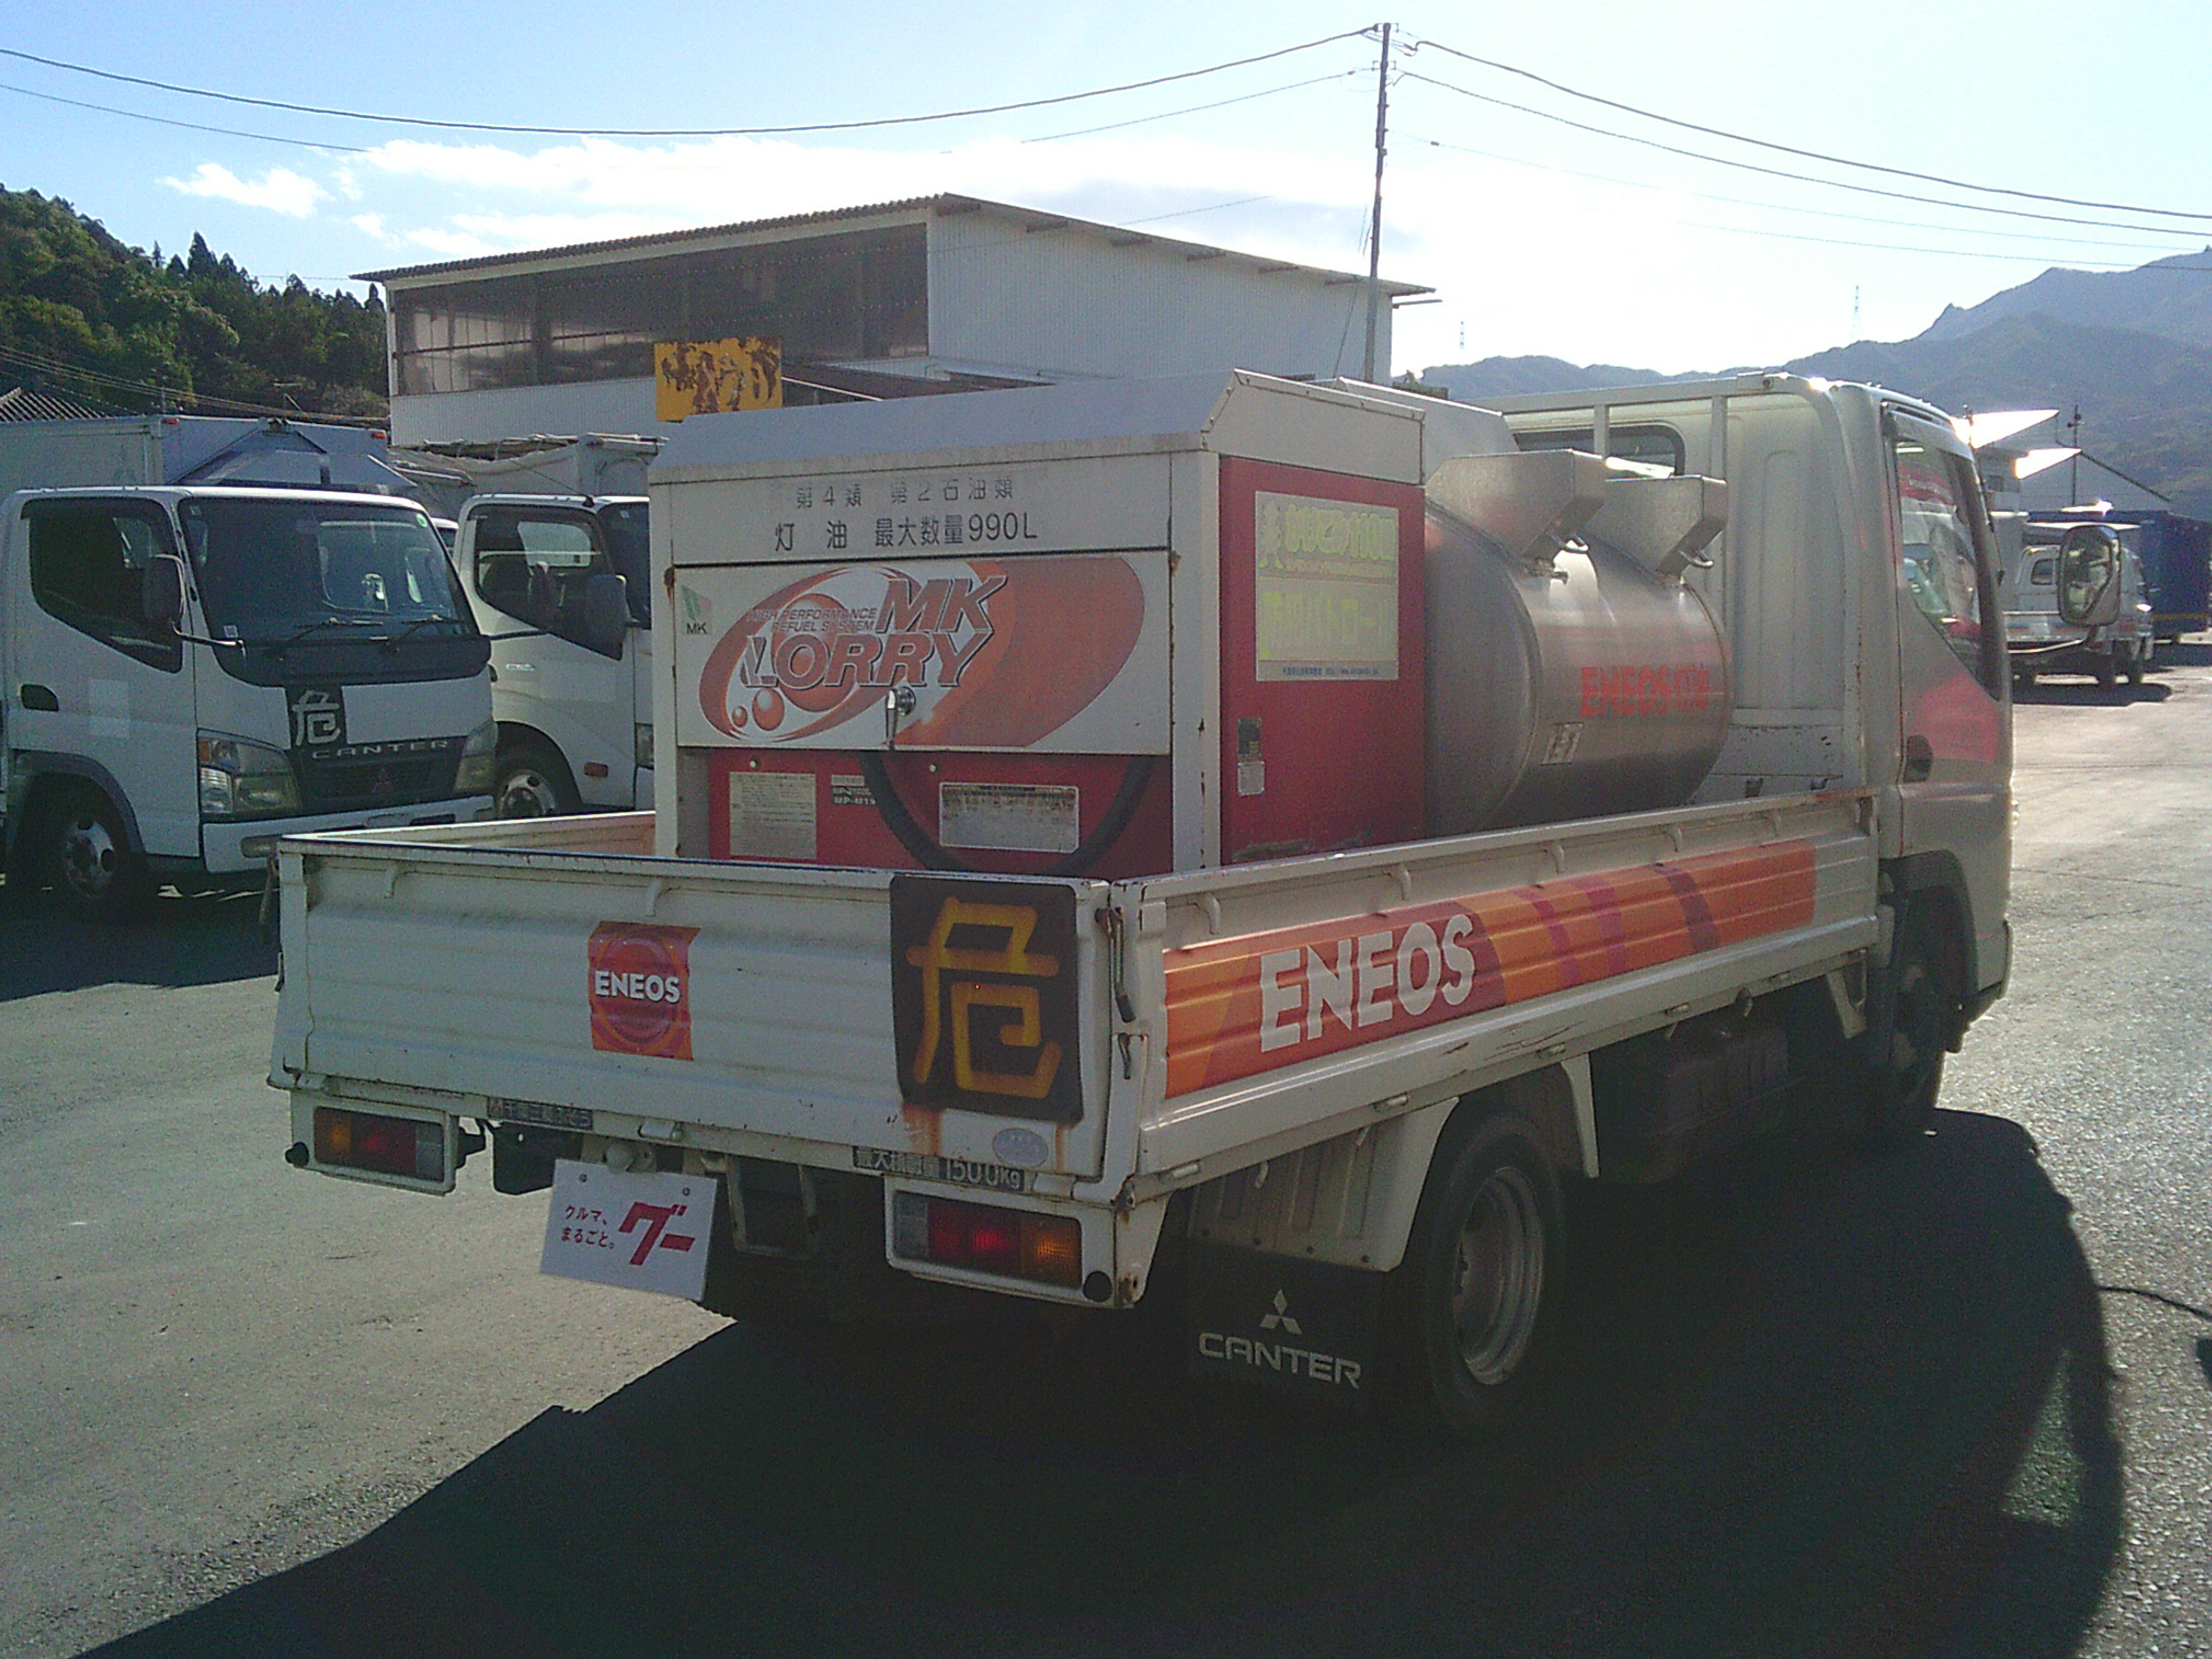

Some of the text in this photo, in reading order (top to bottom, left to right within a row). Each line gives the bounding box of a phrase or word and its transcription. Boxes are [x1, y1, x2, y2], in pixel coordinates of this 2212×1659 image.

[686, 622, 707, 635] MK
[876, 575, 1008, 633] MK
[740, 631, 995, 690] LORRY
[292, 690, 341, 747] 危
[311, 740, 449, 760] CANTER
[595, 970, 681, 1004] ENEOS
[905, 896, 1062, 1099] 危
[1260, 914, 1476, 1053] ENEOS
[561, 1226, 615, 1249] まるごと。
[618, 1201, 696, 1266] グー
[1198, 1332, 1362, 1390] CANTER
